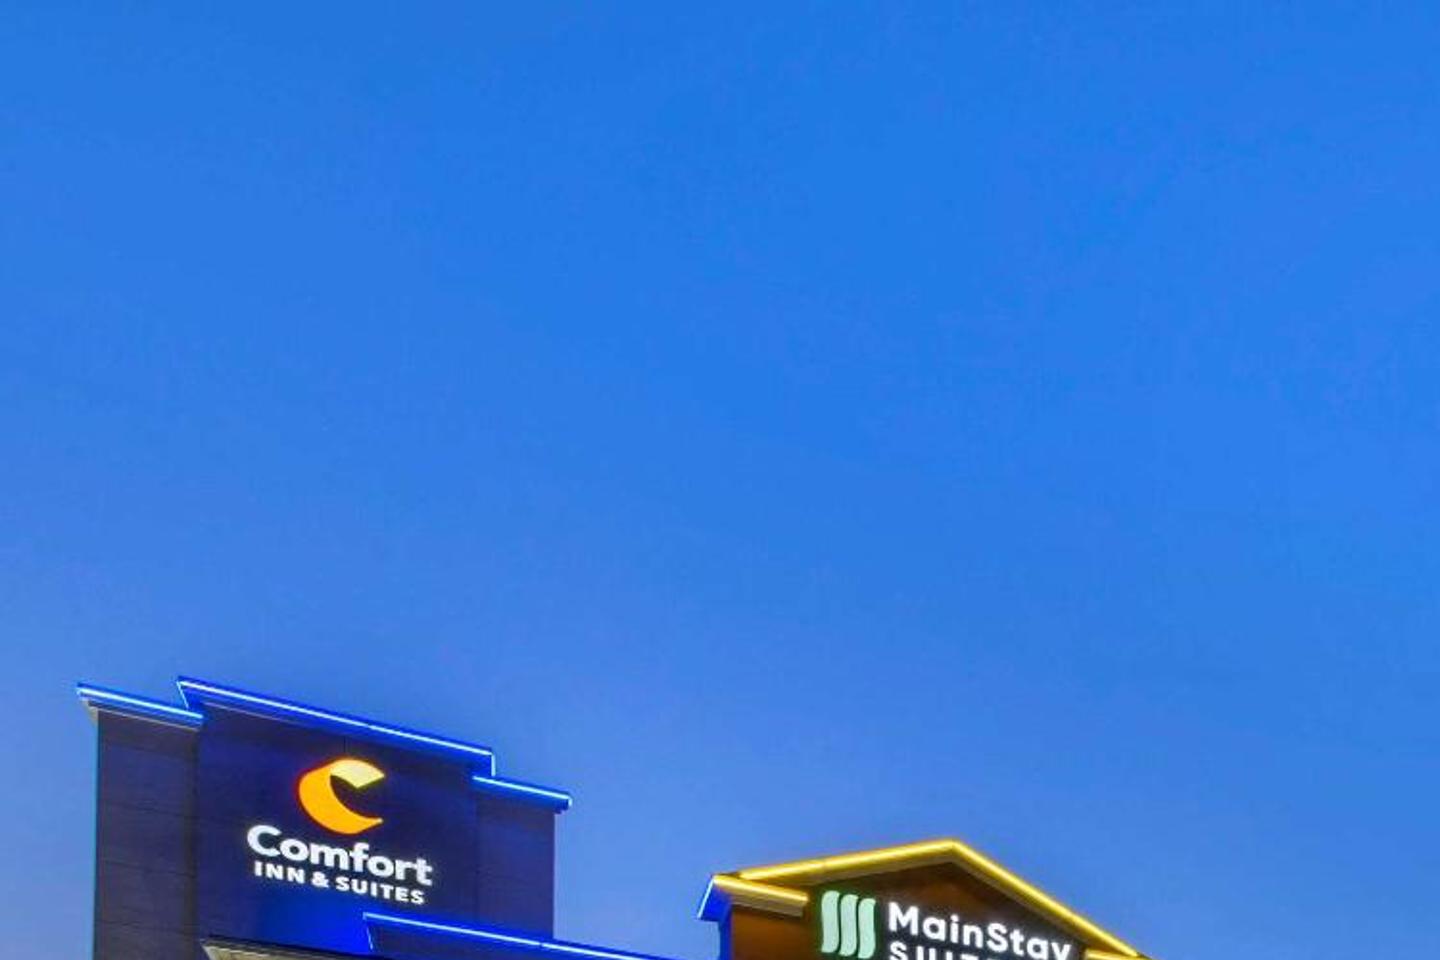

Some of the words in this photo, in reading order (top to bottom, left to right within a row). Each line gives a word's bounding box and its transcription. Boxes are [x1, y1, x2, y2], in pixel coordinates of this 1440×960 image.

[247, 825, 433, 886] Comfort
[254, 860, 305, 884] INN
[311, 871, 329, 888] &
[335, 876, 425, 905] SUITES
